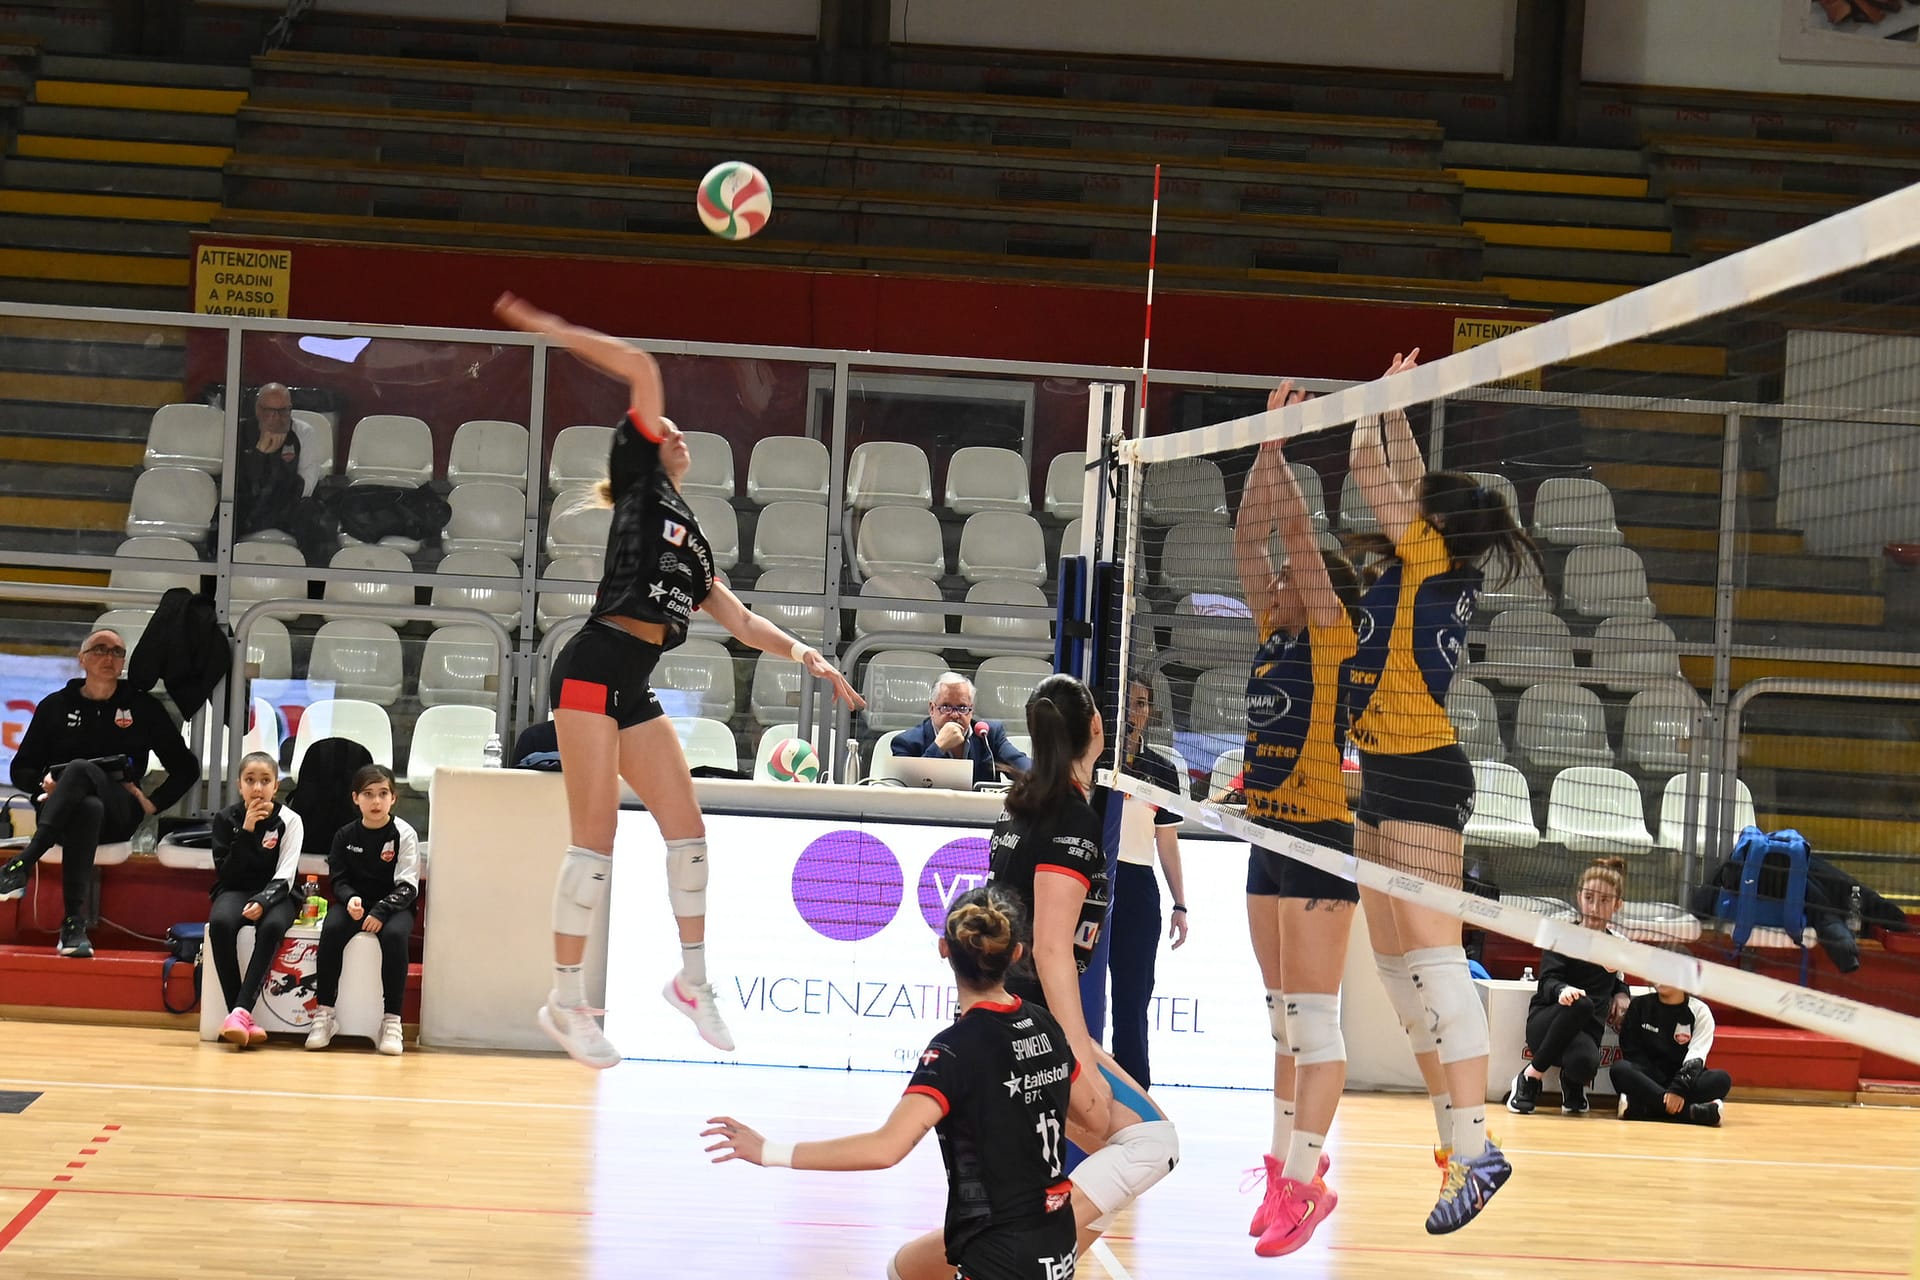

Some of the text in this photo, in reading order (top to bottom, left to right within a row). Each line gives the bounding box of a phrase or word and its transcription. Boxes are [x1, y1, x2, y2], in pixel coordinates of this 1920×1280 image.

[200, 250, 288, 269] ATTENZIONE
[214, 272, 273, 287] GRADINI
[209, 288, 274, 304] A PASSO
[1457, 322, 1529, 339] ATTENZI
[668, 586, 693, 606] Ran
[735, 975, 1205, 1033] VICENZATIE TEL
[1011, 1032, 1053, 1061] SPINELLO
